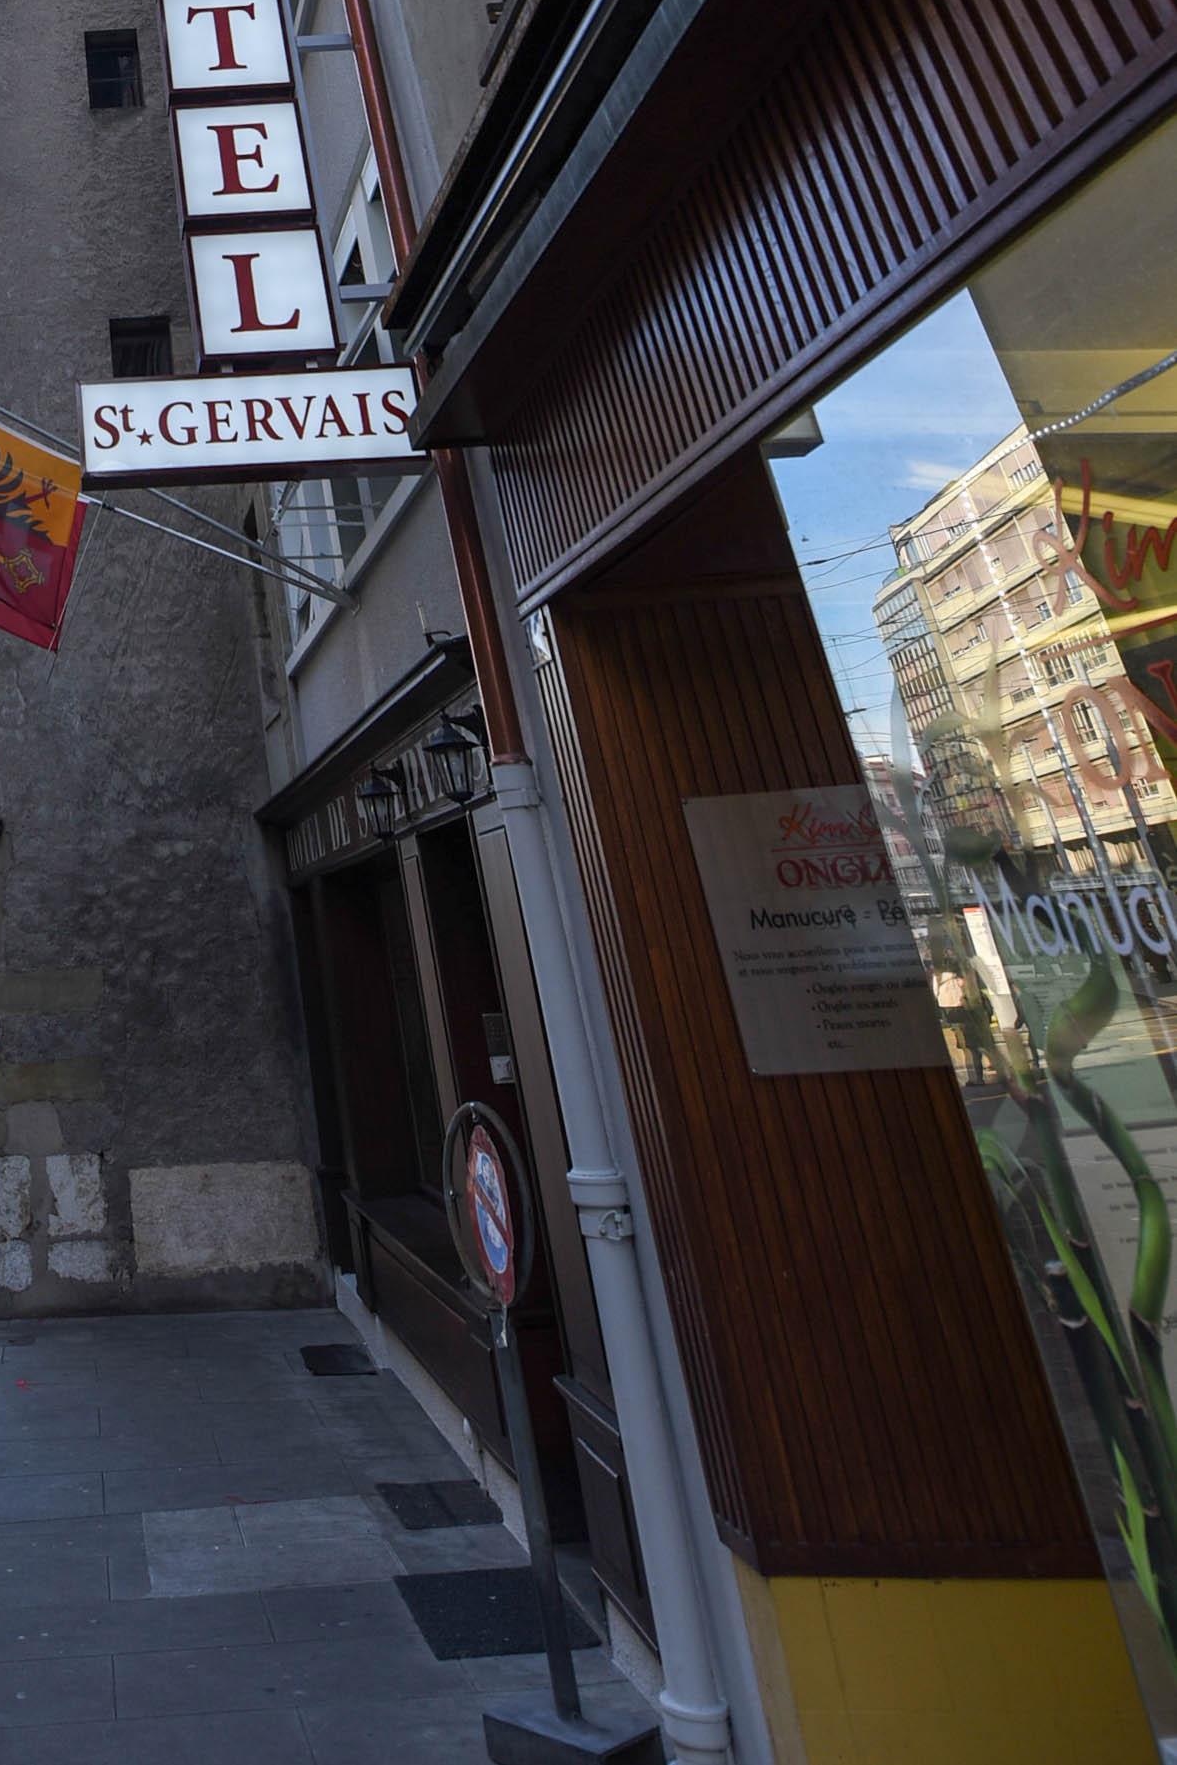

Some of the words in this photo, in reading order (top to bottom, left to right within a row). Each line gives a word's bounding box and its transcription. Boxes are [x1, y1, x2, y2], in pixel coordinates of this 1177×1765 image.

[93, 403, 136, 450] St
[158, 390, 410, 447] GERVAIS
[326, 795, 351, 851] DE
